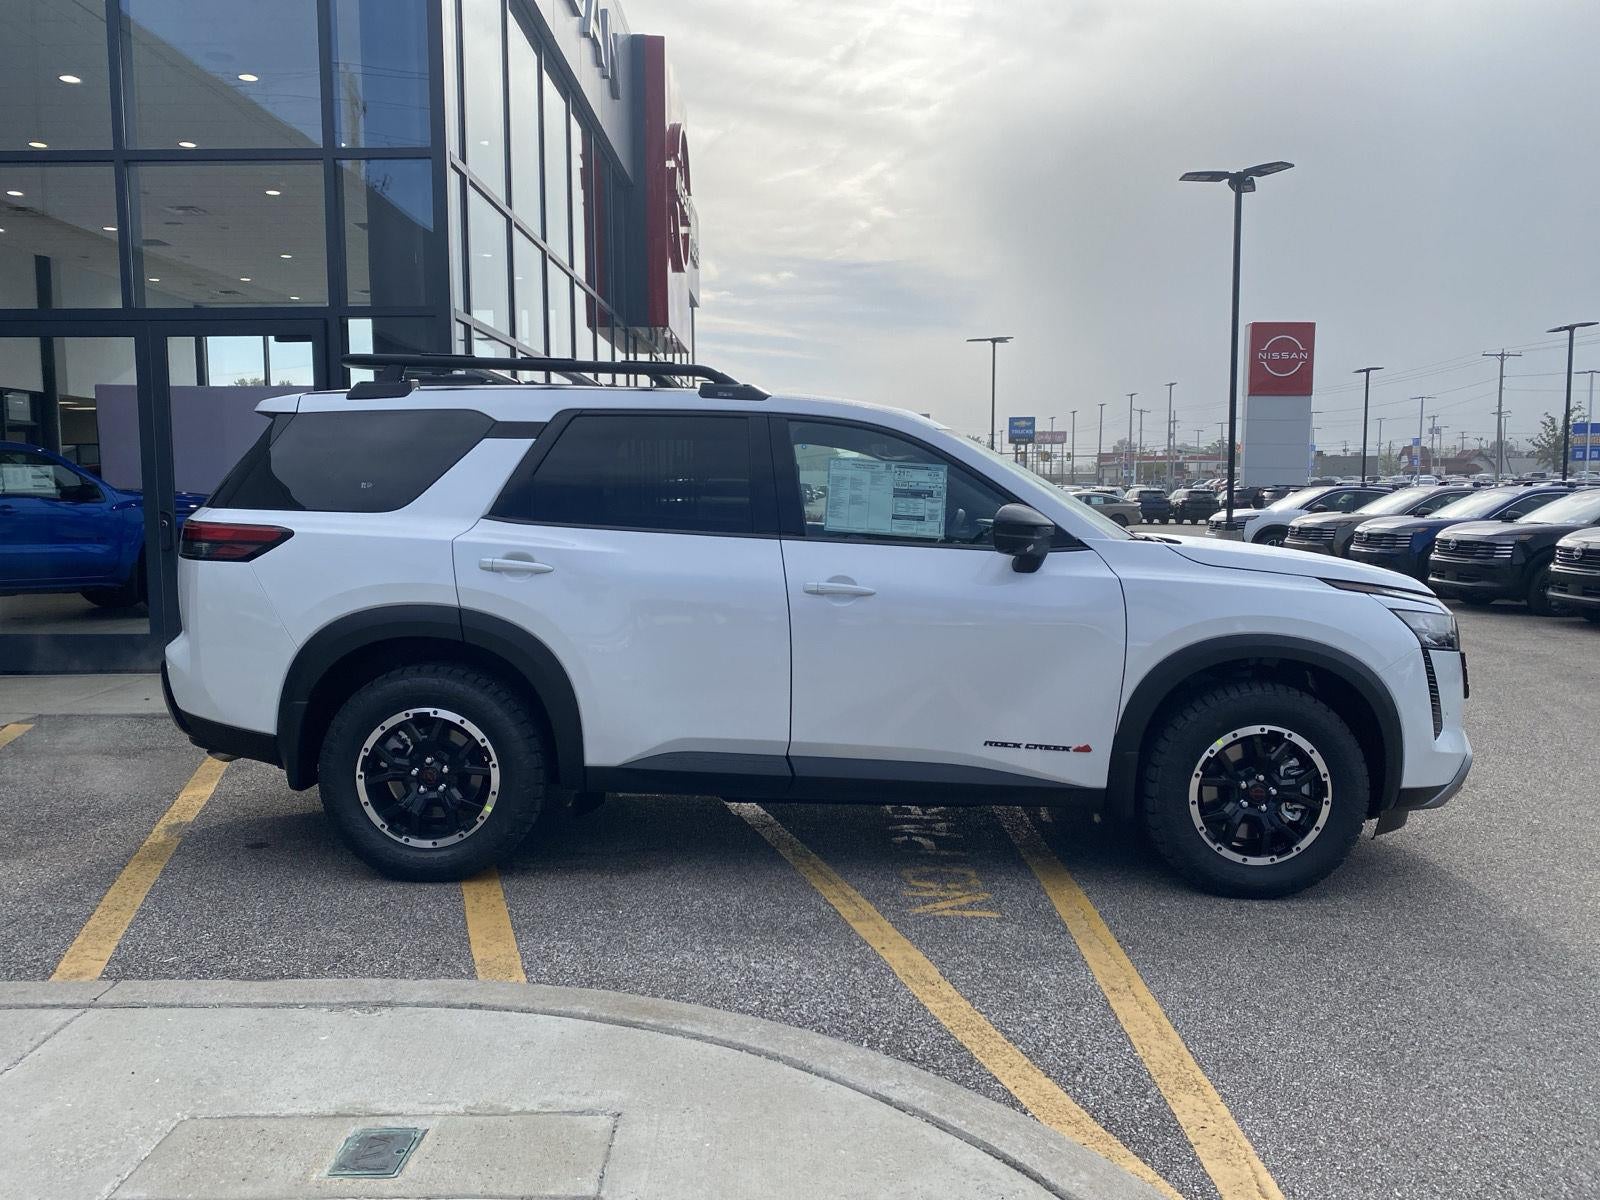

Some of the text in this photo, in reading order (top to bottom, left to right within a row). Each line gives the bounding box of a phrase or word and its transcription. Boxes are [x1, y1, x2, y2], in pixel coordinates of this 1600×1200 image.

[1258, 352, 1308, 360] NISSAN
[983, 740, 1072, 752] ROCK CREEK
